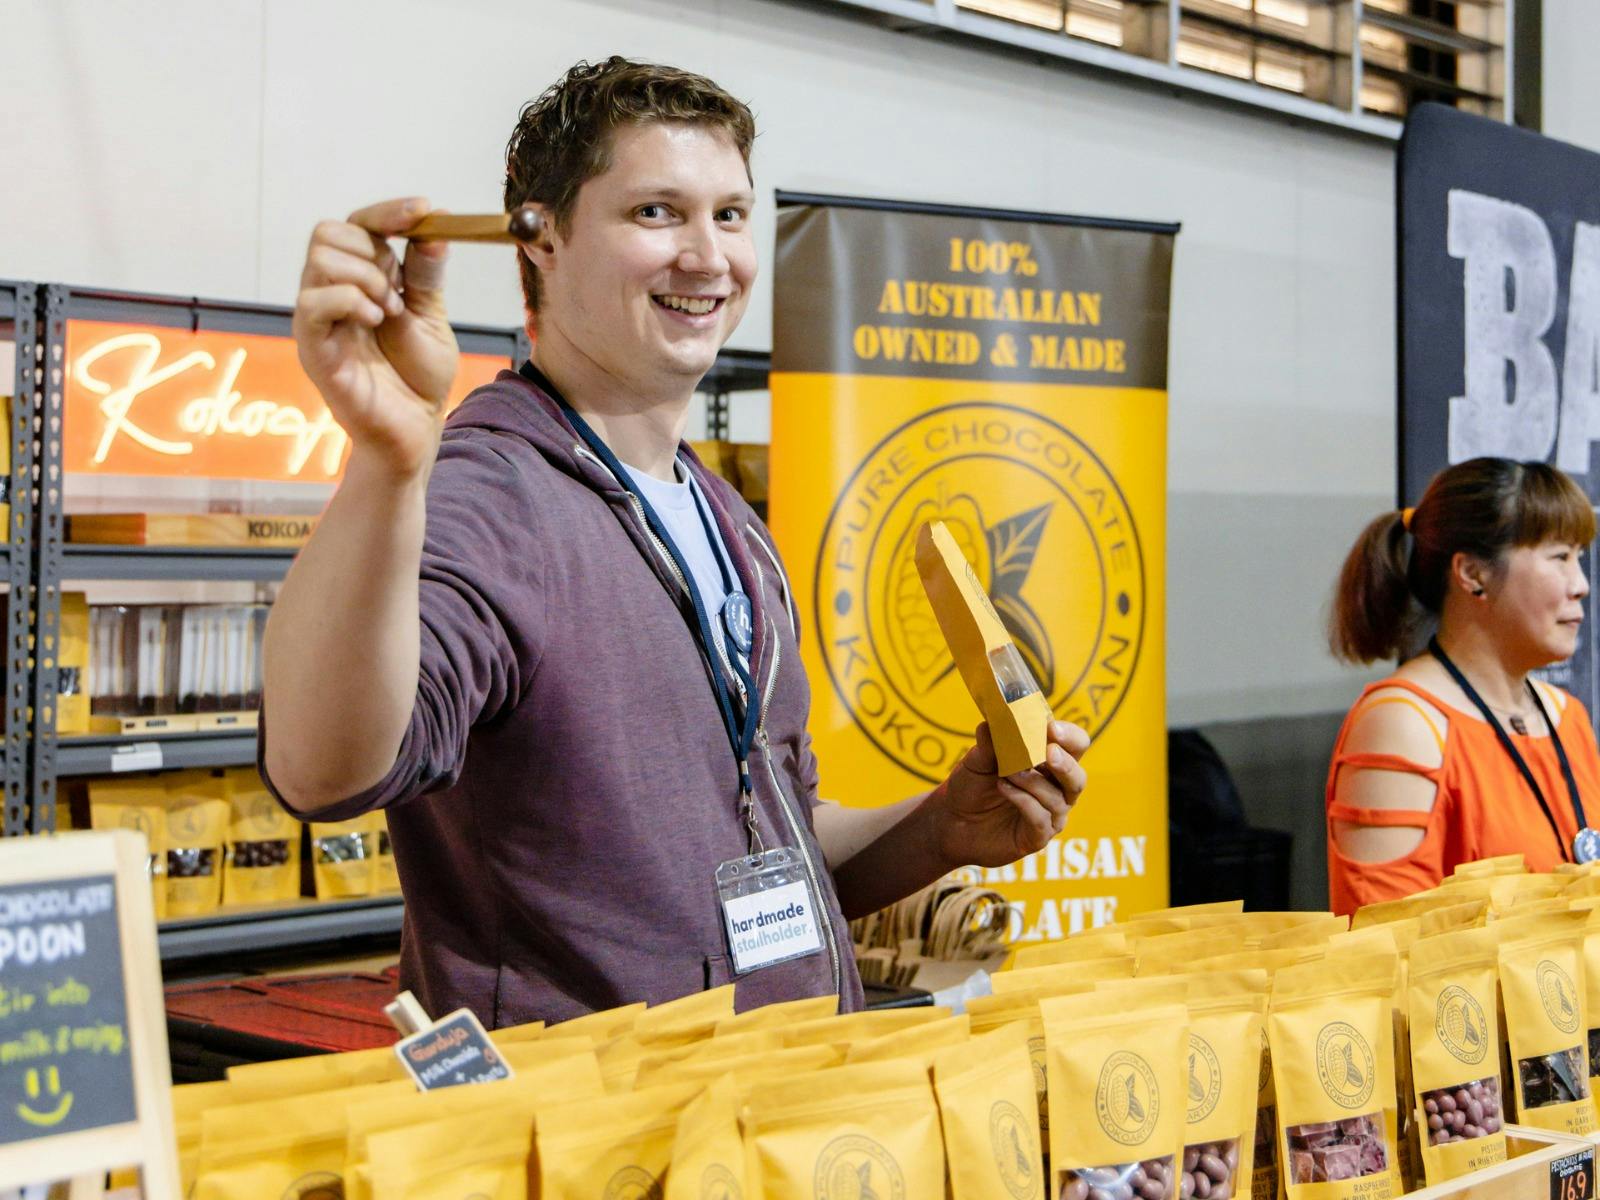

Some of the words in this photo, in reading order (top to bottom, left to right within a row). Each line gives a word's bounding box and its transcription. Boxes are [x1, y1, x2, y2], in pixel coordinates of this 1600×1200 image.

[949, 237, 1039, 277] 100%
[878, 280, 1102, 327] AUSTRALIAN
[853, 323, 981, 365] OWNED
[989, 336, 1018, 368] &
[1029, 334, 1126, 373] MADE
[836, 444, 916, 573] PURE
[923, 420, 1134, 575] CHOCOLATE
[731, 902, 805, 935] handmade
[736, 922, 813, 954] stallholder.
